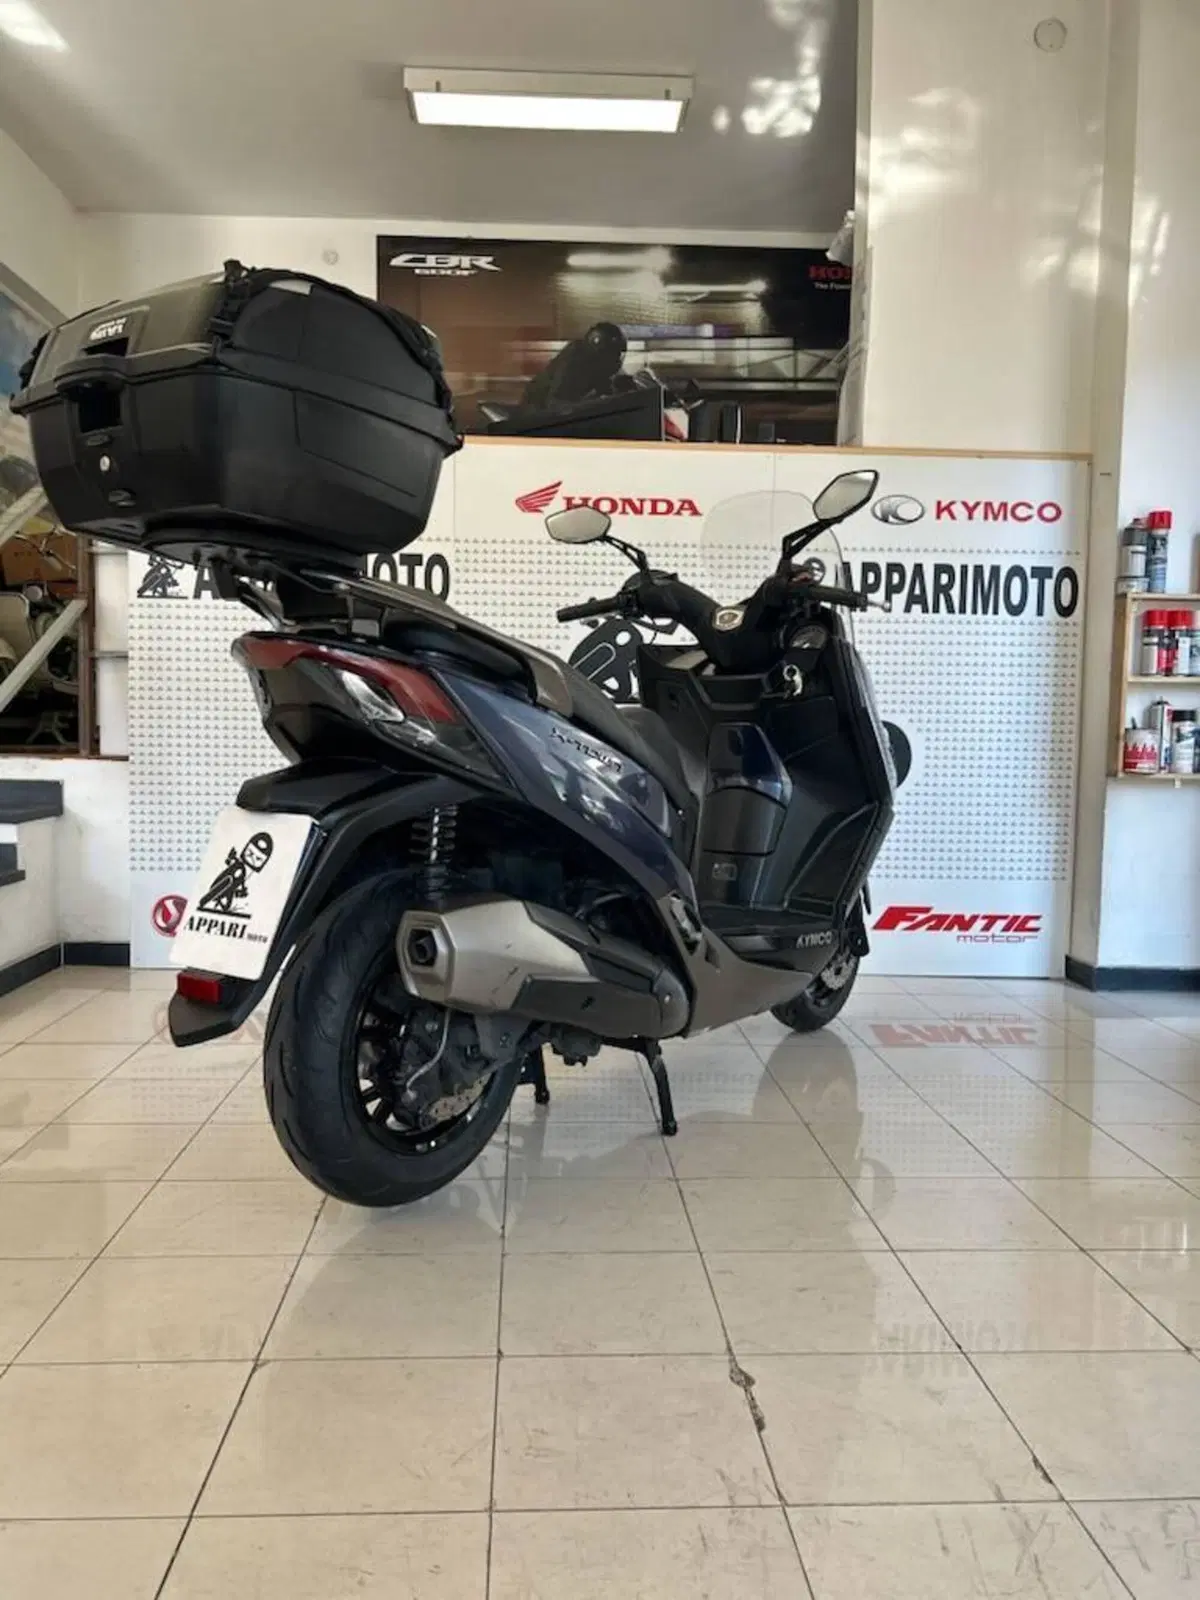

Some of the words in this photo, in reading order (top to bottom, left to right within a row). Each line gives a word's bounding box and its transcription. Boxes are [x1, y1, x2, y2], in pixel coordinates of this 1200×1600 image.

[389, 253, 502, 272] CBR
[562, 496, 703, 516] HONDA
[935, 500, 1062, 523] KYMCO
[184, 915, 247, 940] APPARI
[872, 906, 1043, 932] FANTIC
[956, 934, 1039, 944] motor
